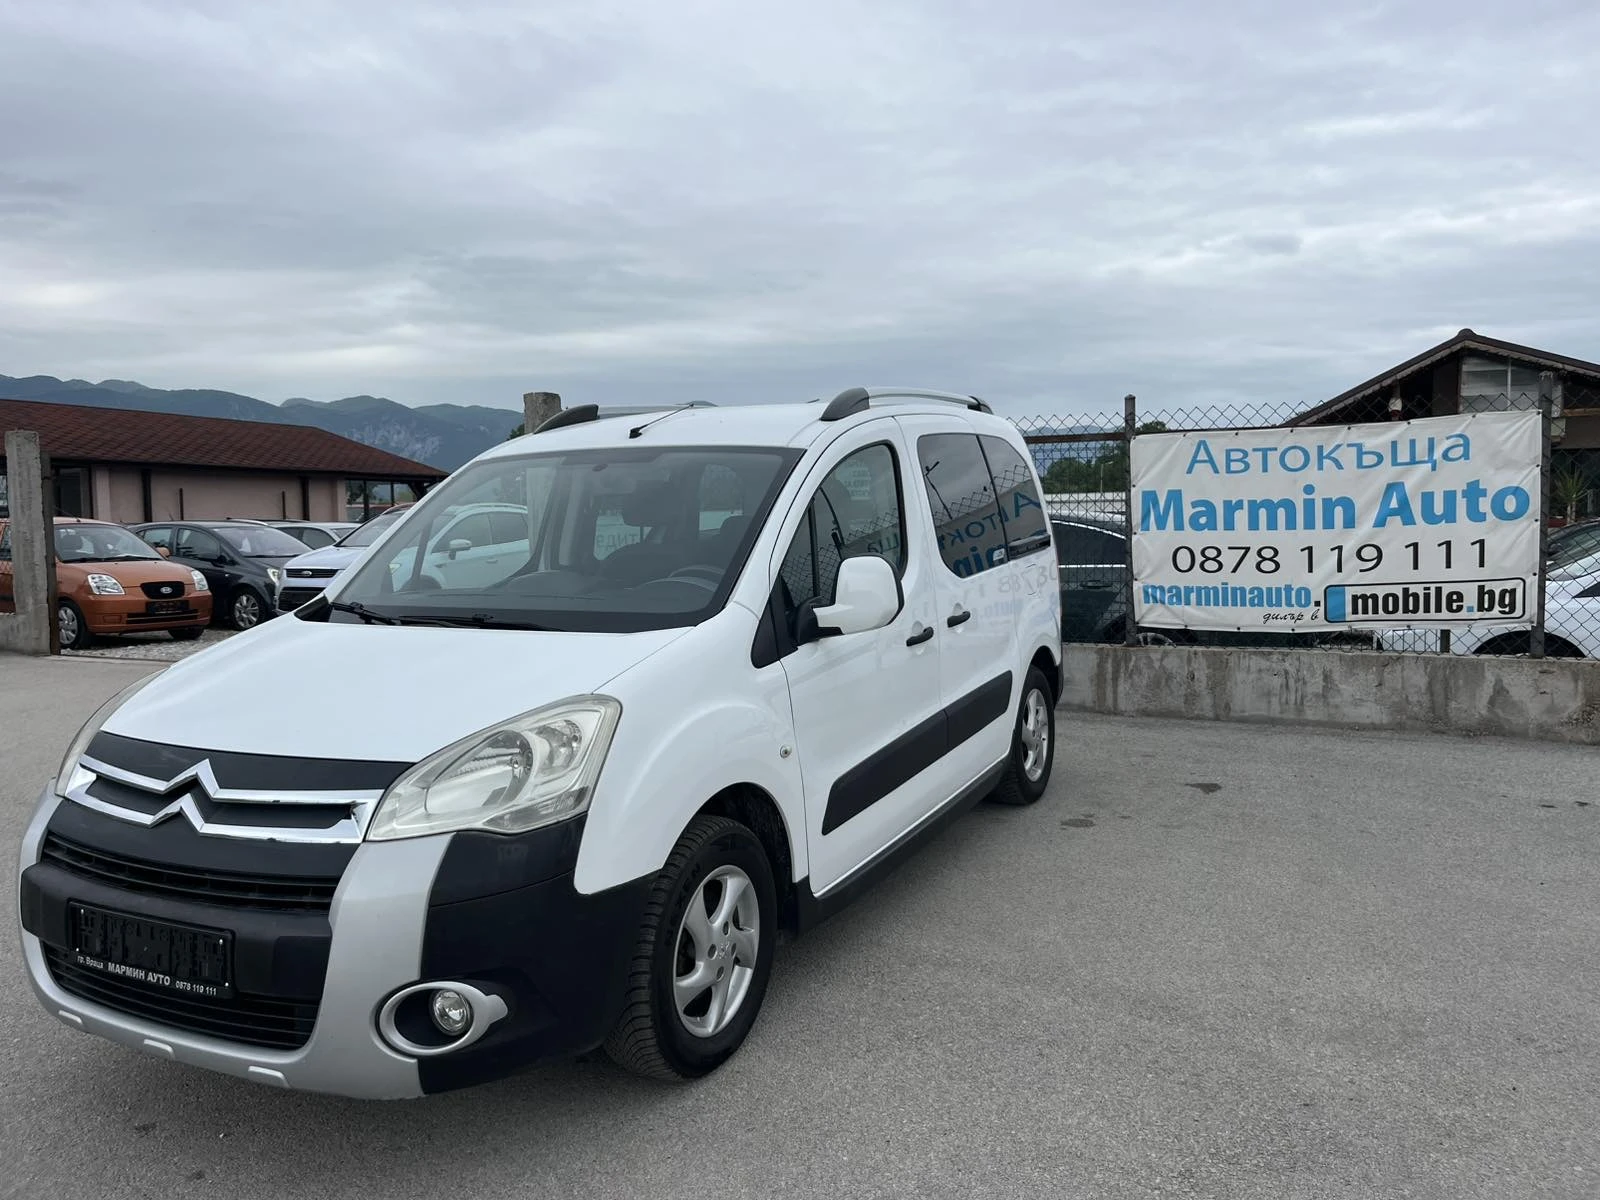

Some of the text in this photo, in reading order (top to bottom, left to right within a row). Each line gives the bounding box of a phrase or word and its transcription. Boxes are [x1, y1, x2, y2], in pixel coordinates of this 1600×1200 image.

[1186, 432, 1471, 475] Автокъща
[1140, 479, 1531, 532] Marmin Auto
[1171, 538, 1487, 574] 0878 119 111
[1351, 585, 1517, 615] mobile.bg
[108, 962, 145, 980] МАРМИН
[147, 972, 171, 986] АУТО
[206, 986, 217, 996] 111
